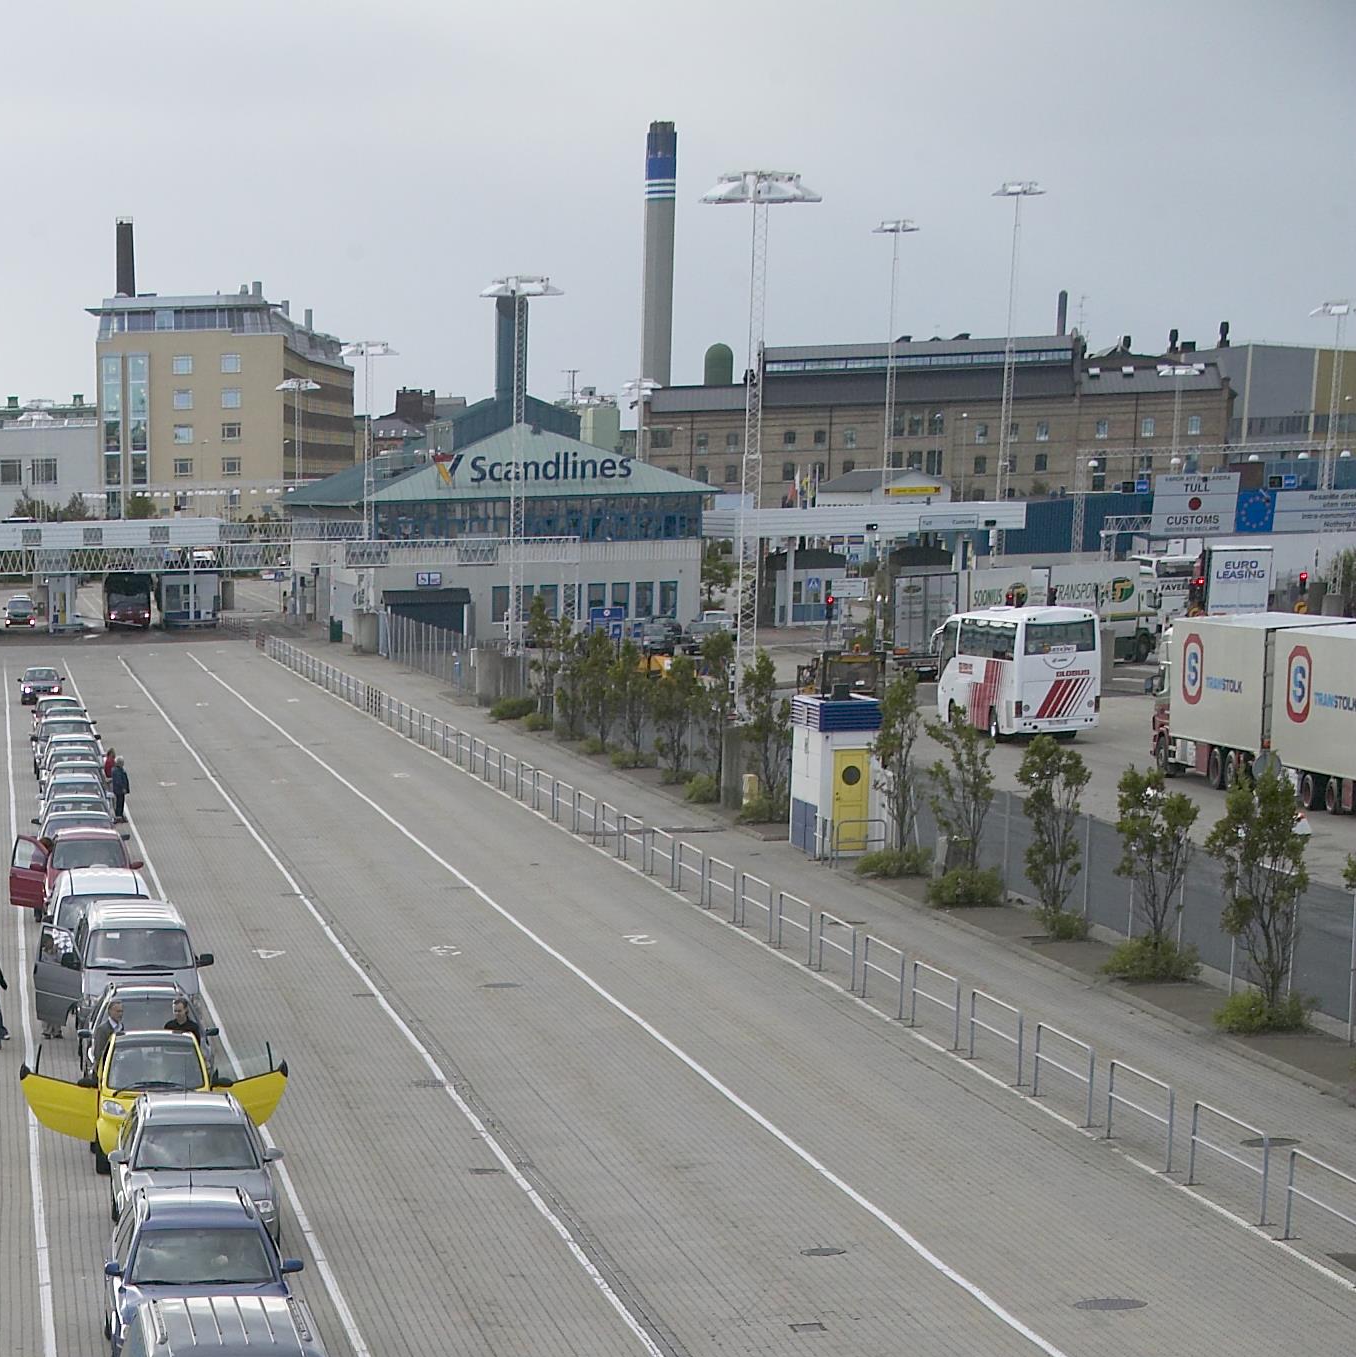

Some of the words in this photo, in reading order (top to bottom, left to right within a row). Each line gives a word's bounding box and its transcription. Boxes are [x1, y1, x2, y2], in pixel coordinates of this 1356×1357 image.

[471, 452, 632, 482] Scandlines
[1184, 483, 1210, 493] TULL
[1166, 515, 1220, 526] CUSTOMS
[1224, 560, 1259, 570] EURO
[1216, 570, 1265, 580] LEASING
[1205, 674, 1244, 695] TRANSTOLK
